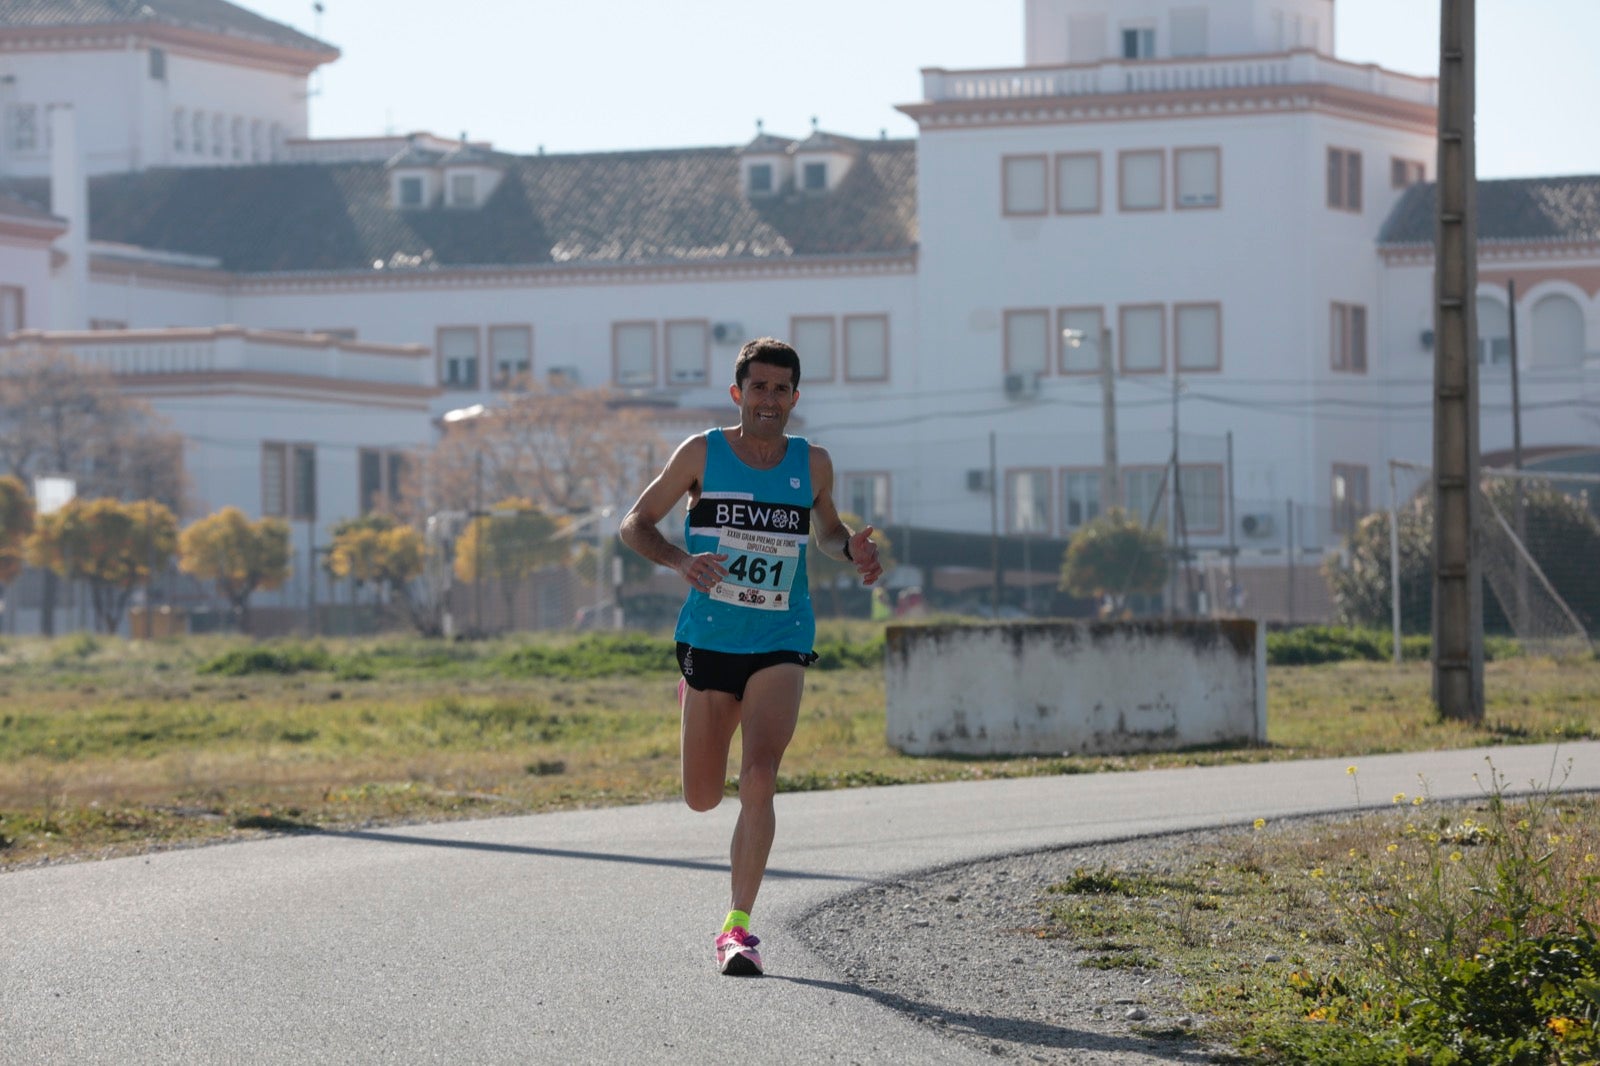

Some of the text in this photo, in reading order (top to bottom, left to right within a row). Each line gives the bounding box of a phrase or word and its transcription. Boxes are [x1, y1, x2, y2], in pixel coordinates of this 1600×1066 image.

[741, 533, 756, 541] GRAN
[756, 535, 775, 546] PREMIO
[729, 555, 783, 587] 461
